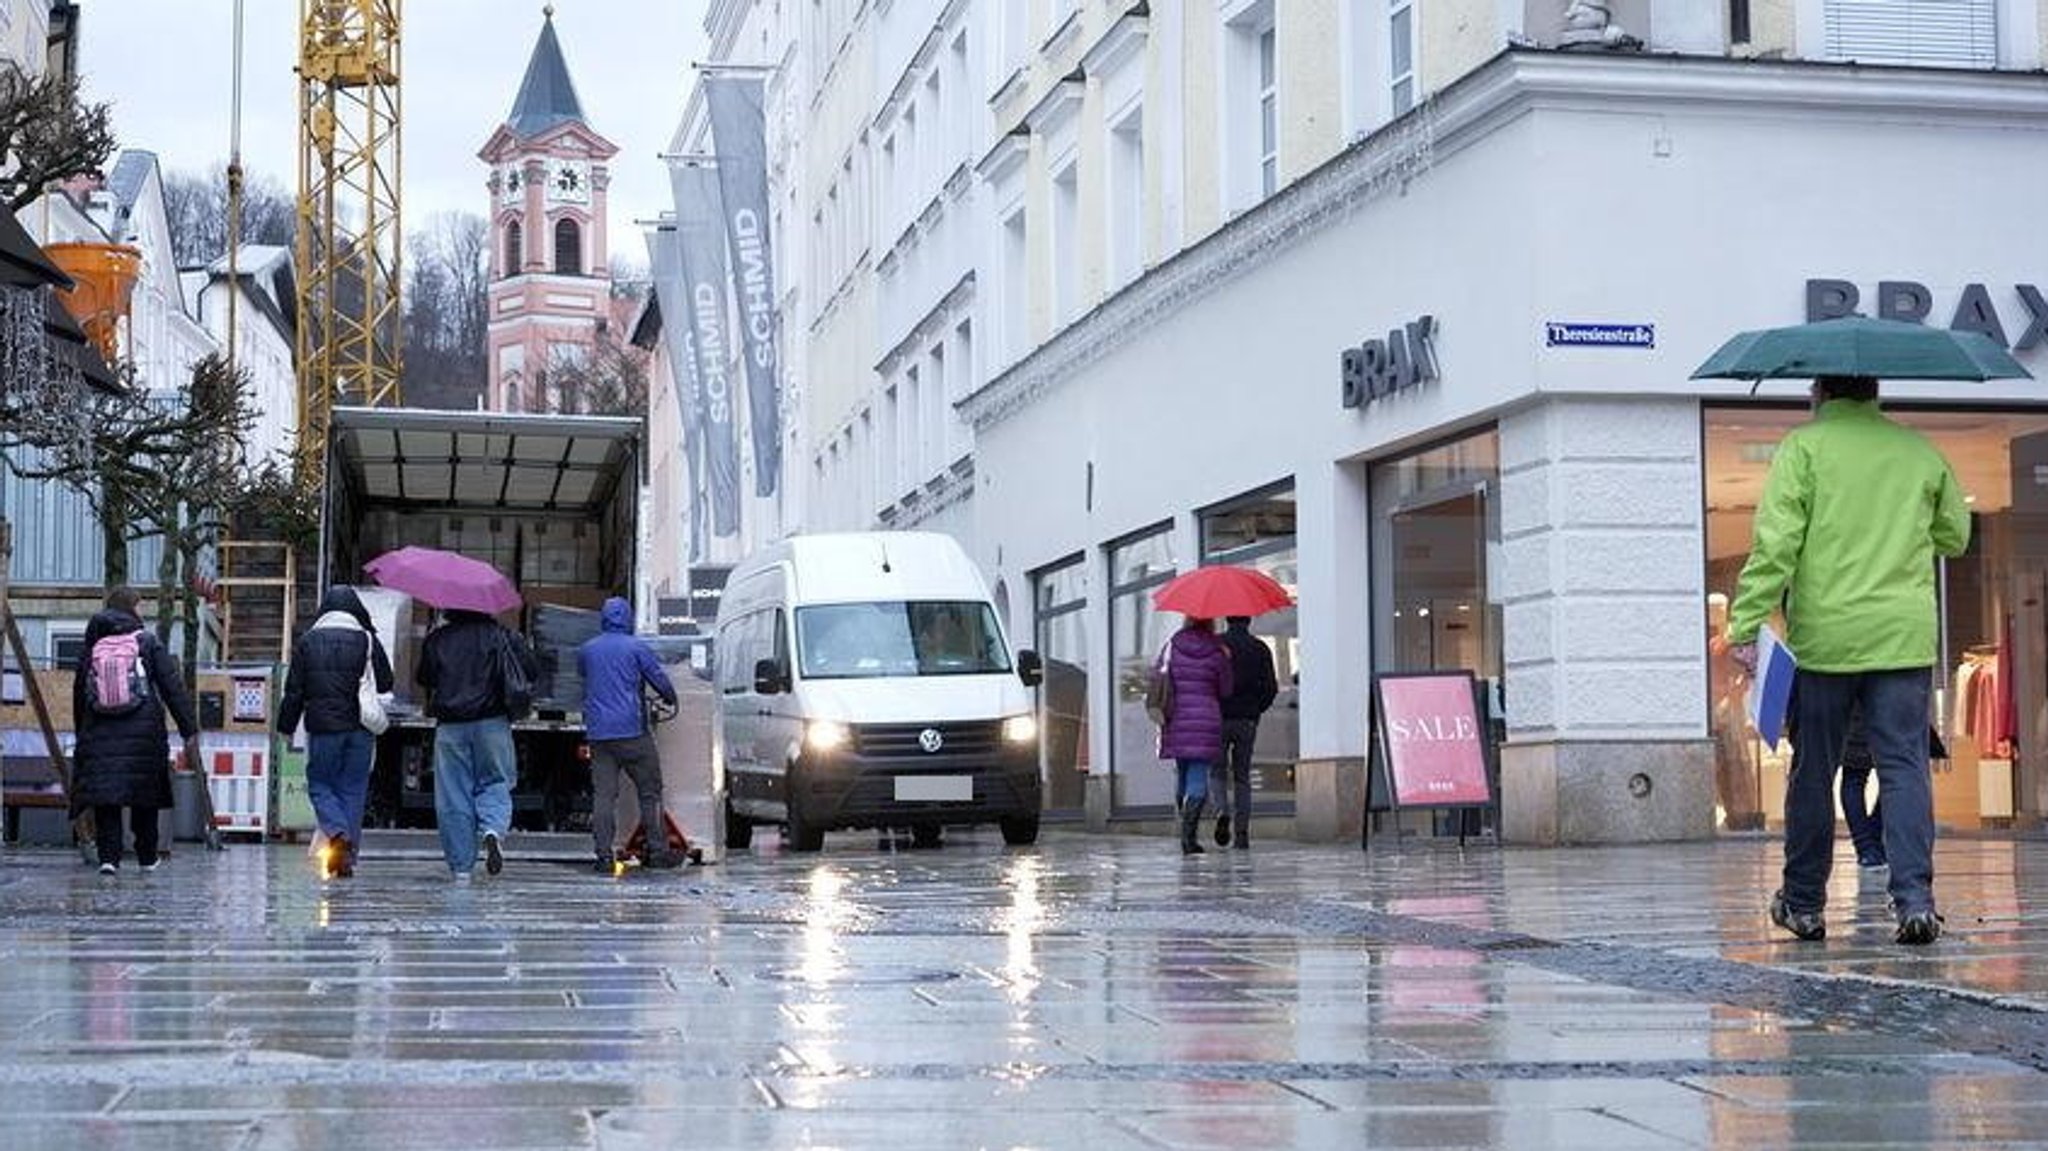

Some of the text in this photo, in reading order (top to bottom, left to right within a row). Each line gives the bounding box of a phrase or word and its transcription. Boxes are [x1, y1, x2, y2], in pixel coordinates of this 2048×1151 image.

[735, 208, 774, 368] SCHMID
[695, 283, 729, 424] SCHMID
[1552, 325, 1651, 343] Theresienstraße
[1391, 715, 1475, 741] SALE
